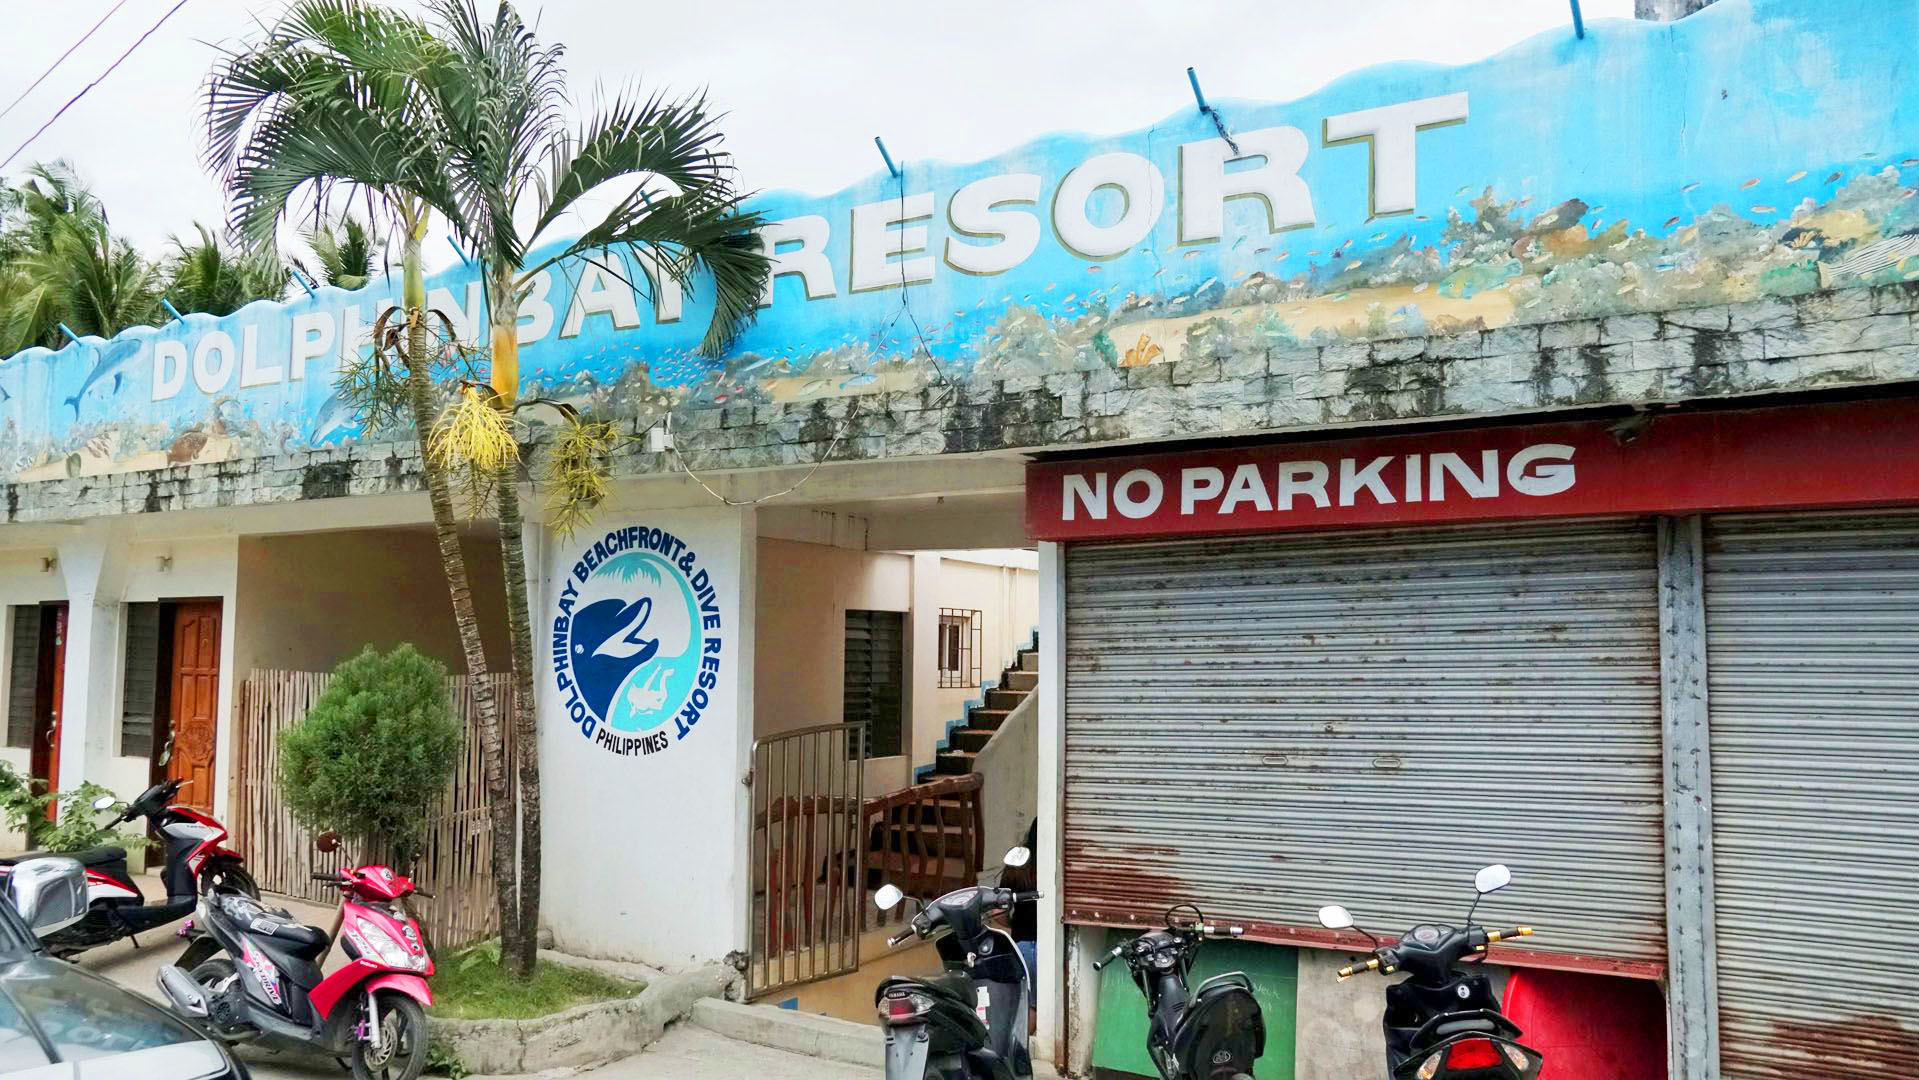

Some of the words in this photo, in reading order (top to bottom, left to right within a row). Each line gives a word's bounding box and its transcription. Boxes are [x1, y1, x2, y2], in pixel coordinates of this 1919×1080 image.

[151, 240, 690, 402] DOLPHNBAY
[750, 91, 1469, 308] RESORT
[1062, 468, 1164, 521] NO
[1180, 443, 1577, 515] PARKING
[690, 568, 722, 630] DIVE
[553, 579, 597, 739] DOLPHINBAY
[676, 637, 722, 740] RESORT
[596, 727, 669, 756] PHILIPPINES
